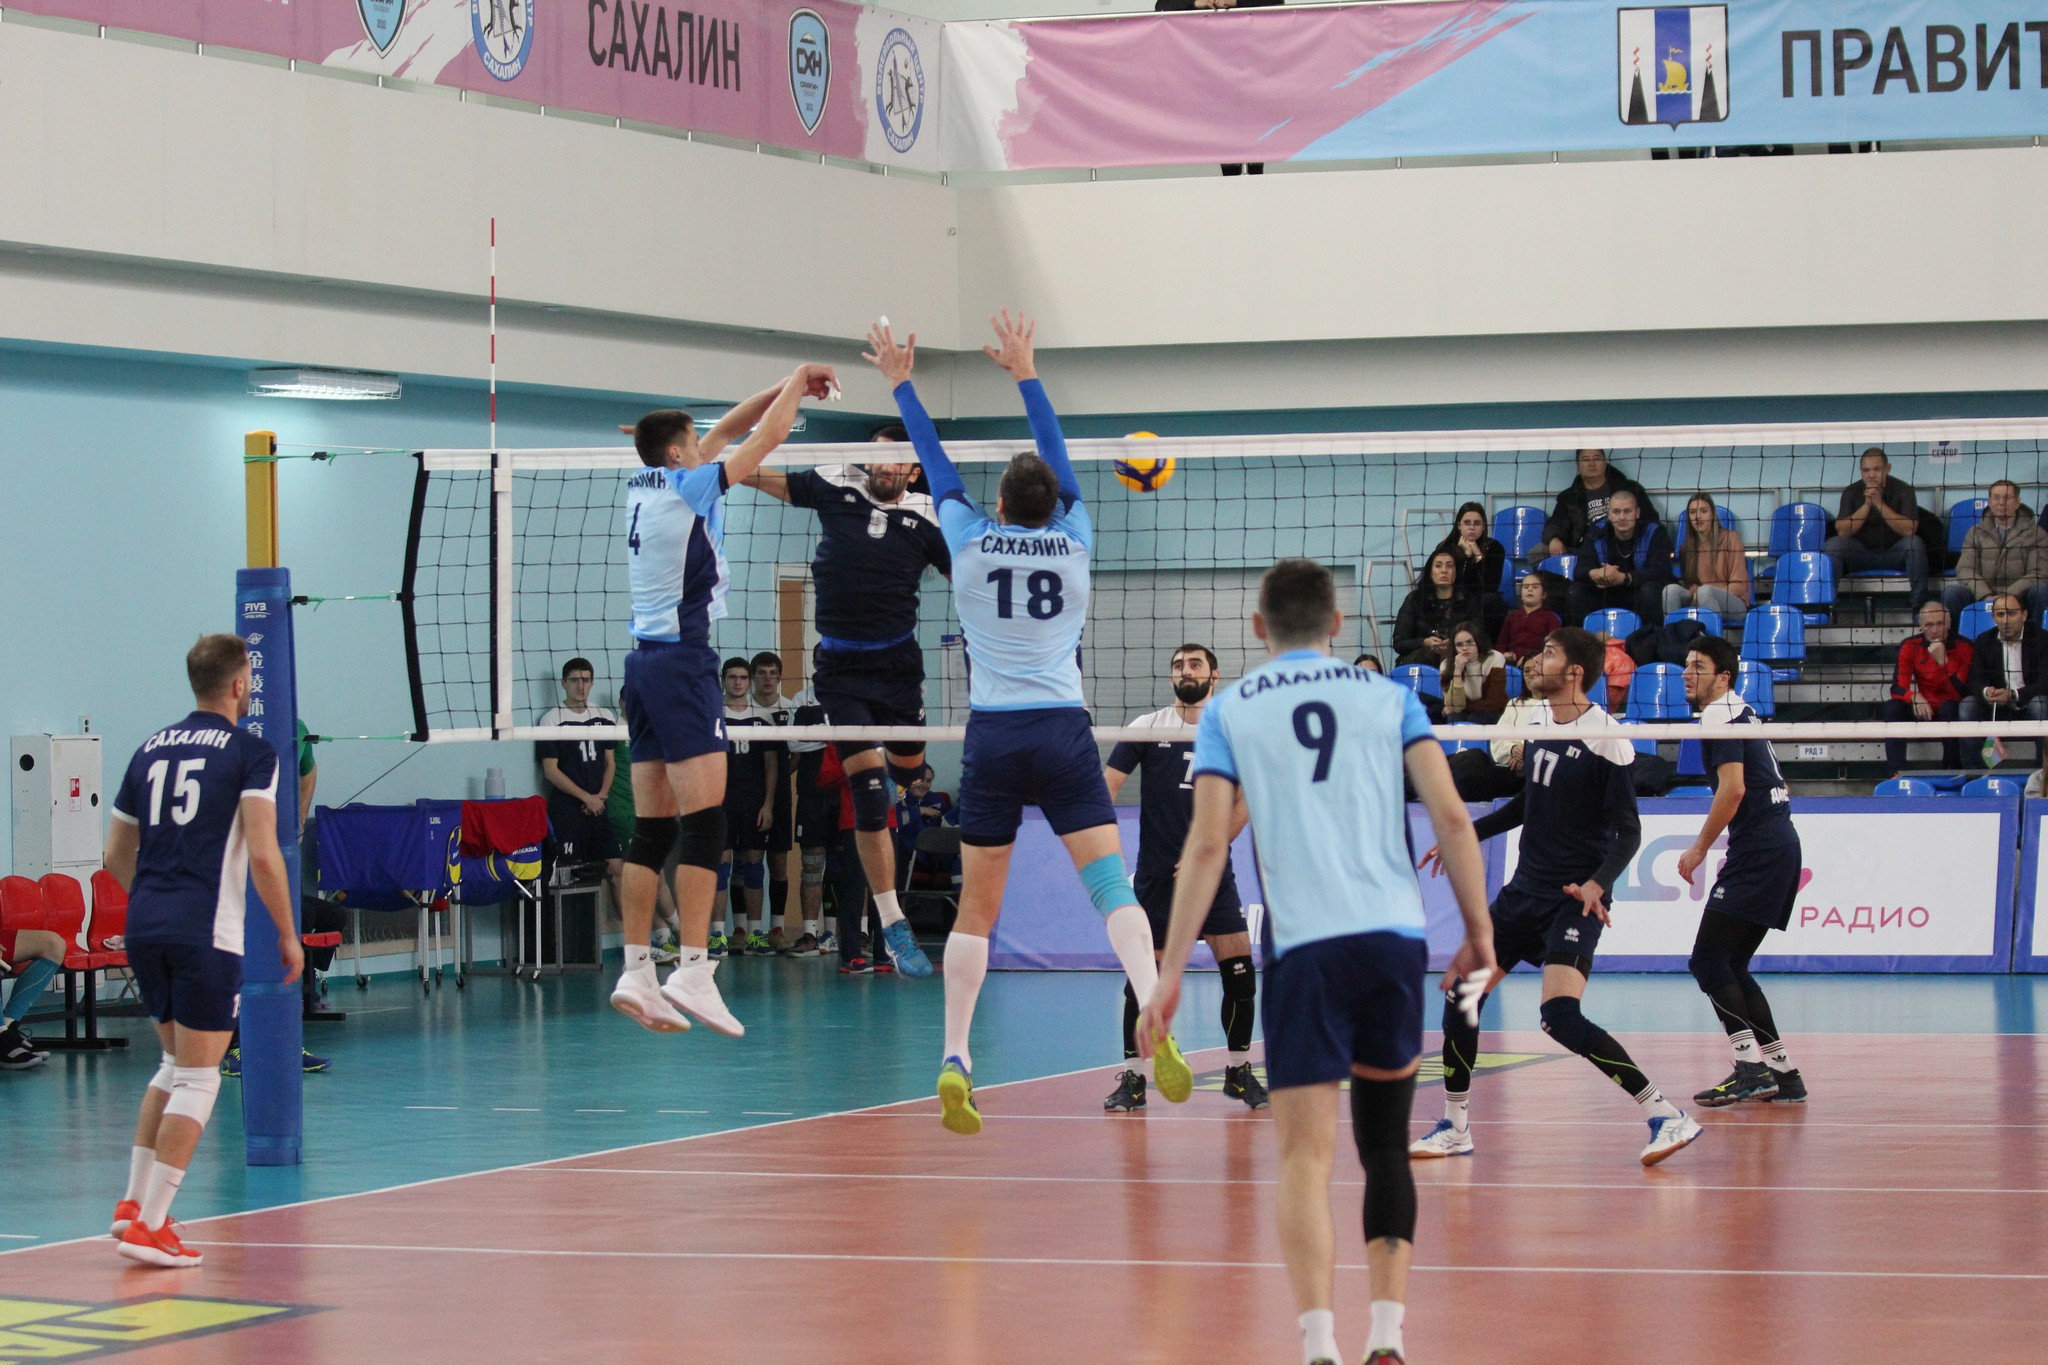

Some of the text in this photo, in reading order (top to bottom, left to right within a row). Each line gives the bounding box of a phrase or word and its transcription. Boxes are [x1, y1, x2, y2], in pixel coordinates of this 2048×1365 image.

[588, 0, 741, 92] САХАЛИН
[1781, 21, 2048, 98] ПРАВИТ
[483, 51, 522, 79] САХАЛИН
[628, 502, 642, 556] 4
[867, 508, 888, 539] 5
[981, 535, 1070, 557] САХАЛИН
[244, 602, 267, 612] FIVB
[986, 568, 1065, 621] 18
[1240, 665, 1372, 700] САХАЛИН
[143, 729, 233, 753] САХАЛИН
[579, 740, 597, 762] 14
[1292, 699, 1338, 783] 9
[1532, 747, 1560, 787] 17
[146, 757, 207, 827] 15
[563, 842, 573, 855] 14
[1800, 906, 1930, 934] РАДИО
[231, 993, 241, 1018] 1
